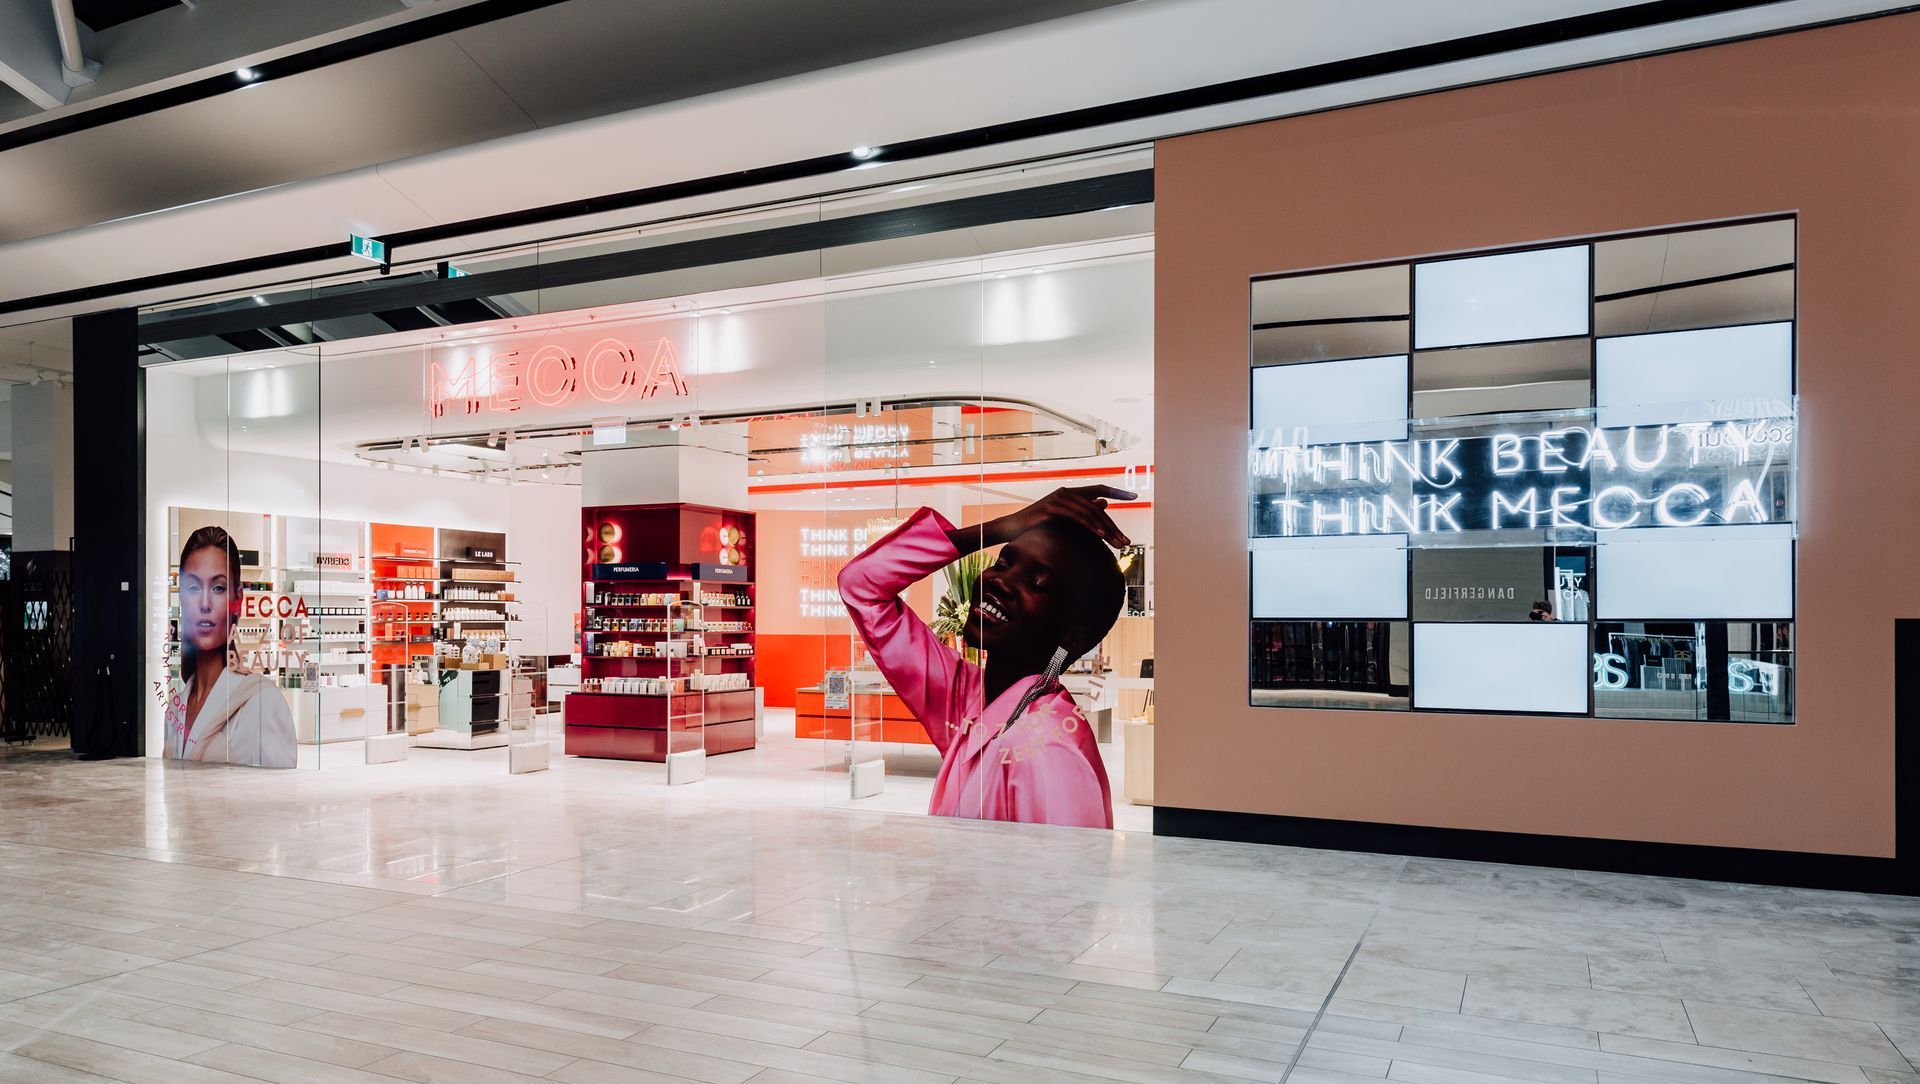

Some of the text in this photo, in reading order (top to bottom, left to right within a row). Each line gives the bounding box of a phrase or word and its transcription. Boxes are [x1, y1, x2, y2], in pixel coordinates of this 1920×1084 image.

[430, 336, 689, 418] MECCA
[1271, 419, 1768, 483] THINK BEAUTY
[1271, 479, 1768, 536] THINK MECCA
[800, 528, 848, 541] THINK
[800, 543, 848, 556] THINK
[281, 623, 309, 645] OF
[227, 650, 307, 673] BEAUTY
[169, 687, 187, 717] FOR
